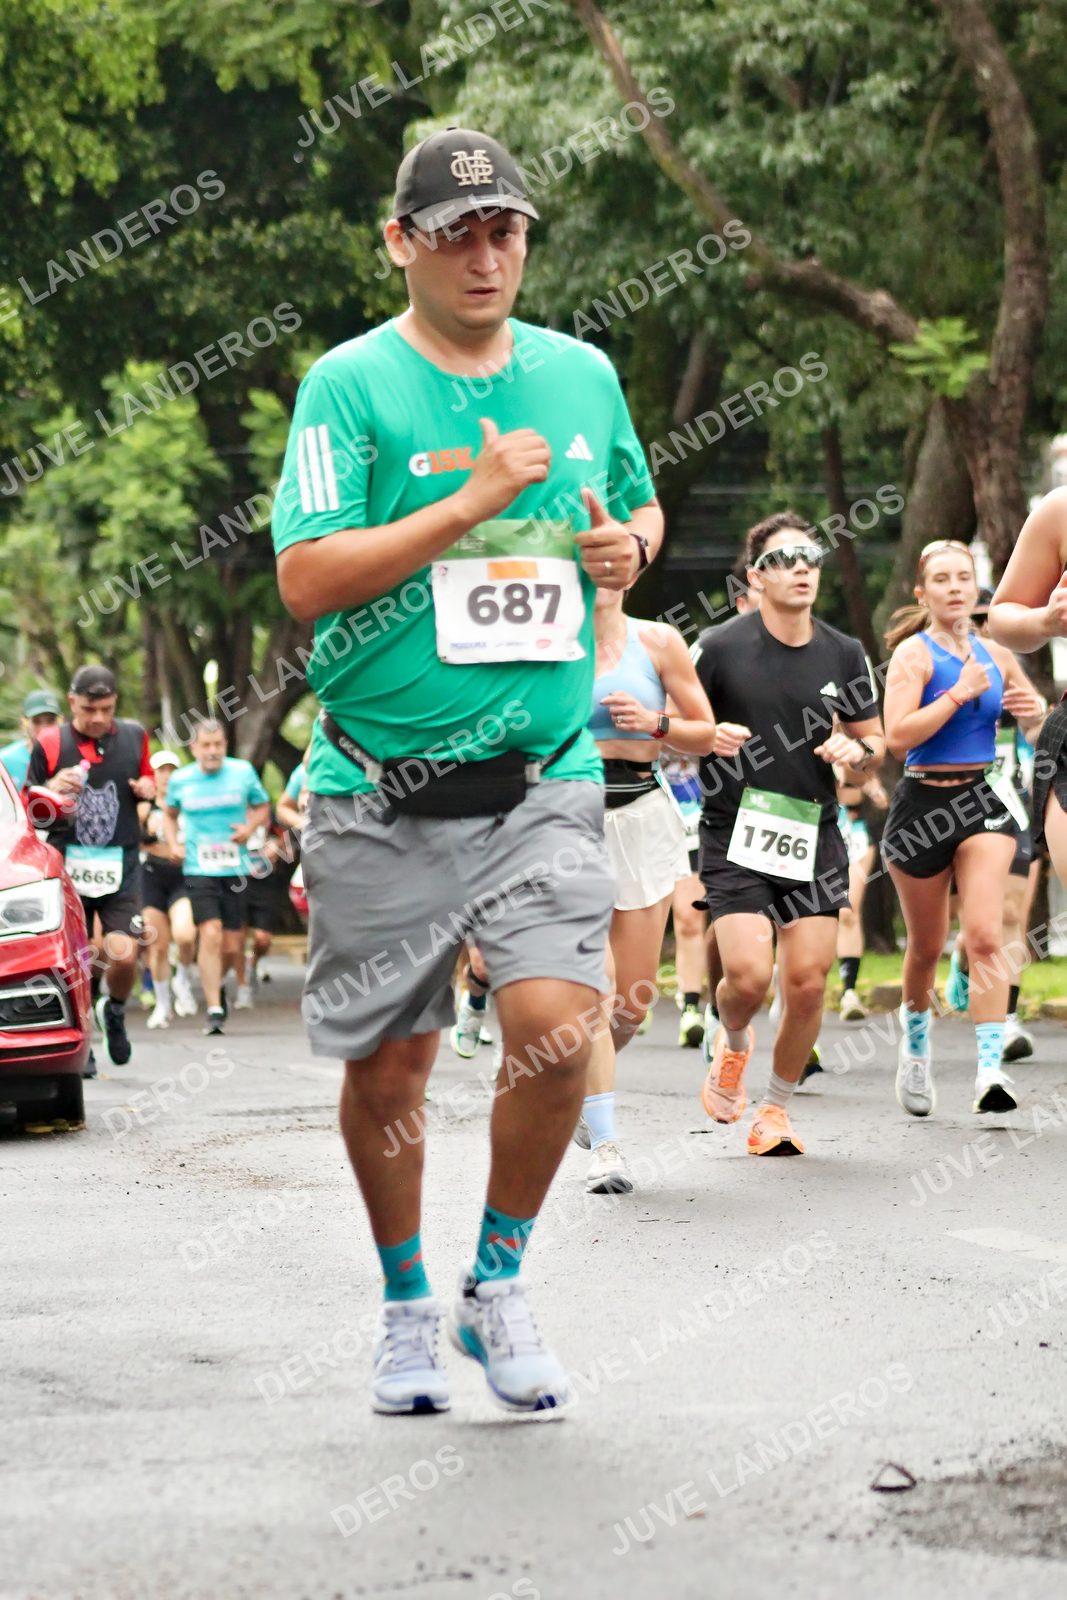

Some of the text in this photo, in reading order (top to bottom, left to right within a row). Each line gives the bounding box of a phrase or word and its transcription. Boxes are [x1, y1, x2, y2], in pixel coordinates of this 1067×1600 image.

[467, 583, 562, 626] 687
[743, 824, 809, 861] 1766
[71, 868, 116, 885] 4665
